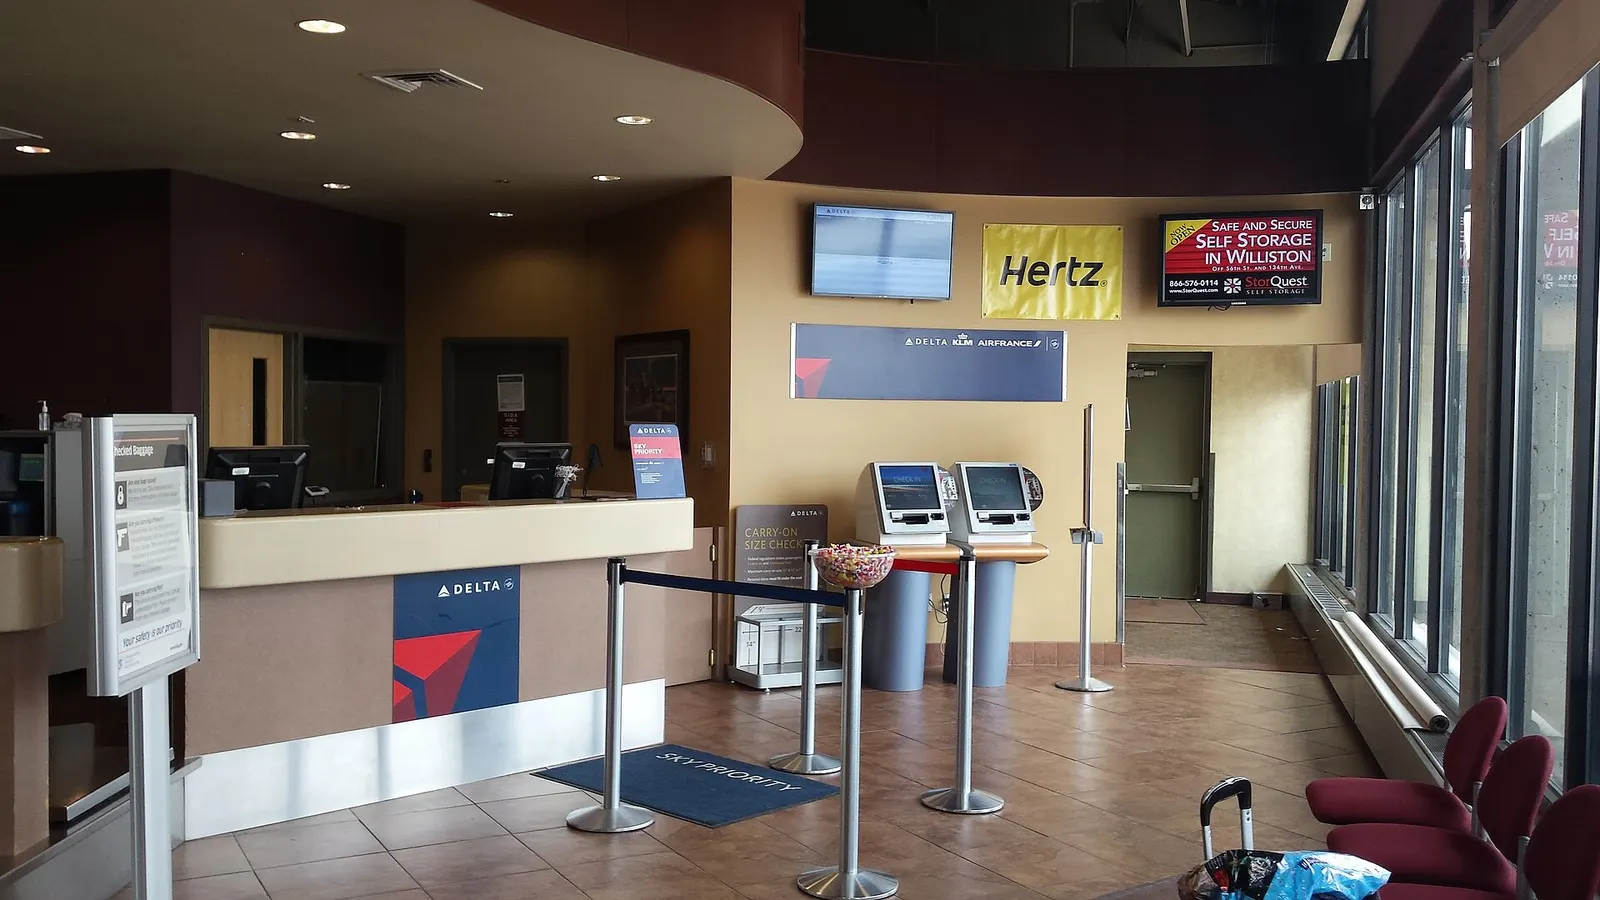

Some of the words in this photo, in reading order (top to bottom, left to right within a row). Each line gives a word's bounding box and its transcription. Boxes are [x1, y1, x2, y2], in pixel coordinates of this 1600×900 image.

[1170, 223, 1186, 238] NOW
[1212, 221, 1239, 232] SAFE
[1242, 222, 1267, 230] AND
[1270, 220, 1312, 230] SECURE
[1171, 225, 1196, 245] OPEN
[1196, 233, 1232, 248] SELF
[1238, 232, 1312, 247] STORAGE
[1205, 252, 1220, 264] IN
[1226, 250, 1311, 264] WILLISTON
[1000, 256, 1103, 287] Hertz
[1245, 276, 1308, 289] StorQuest
[114, 446, 132, 456] hecked
[133, 445, 153, 456] Baggage
[745, 528, 798, 537] CARRY-ON
[744, 540, 766, 550] SIZE
[769, 540, 802, 549] CHECK
[454, 581, 500, 594] DELTA
[123, 636, 135, 648] Your
[135, 632, 150, 644] safety
[151, 628, 156, 637] is
[156, 626, 164, 636] our
[165, 619, 182, 632] priority
[656, 752, 704, 765] SKY
[695, 762, 802, 791] PRIORITY
